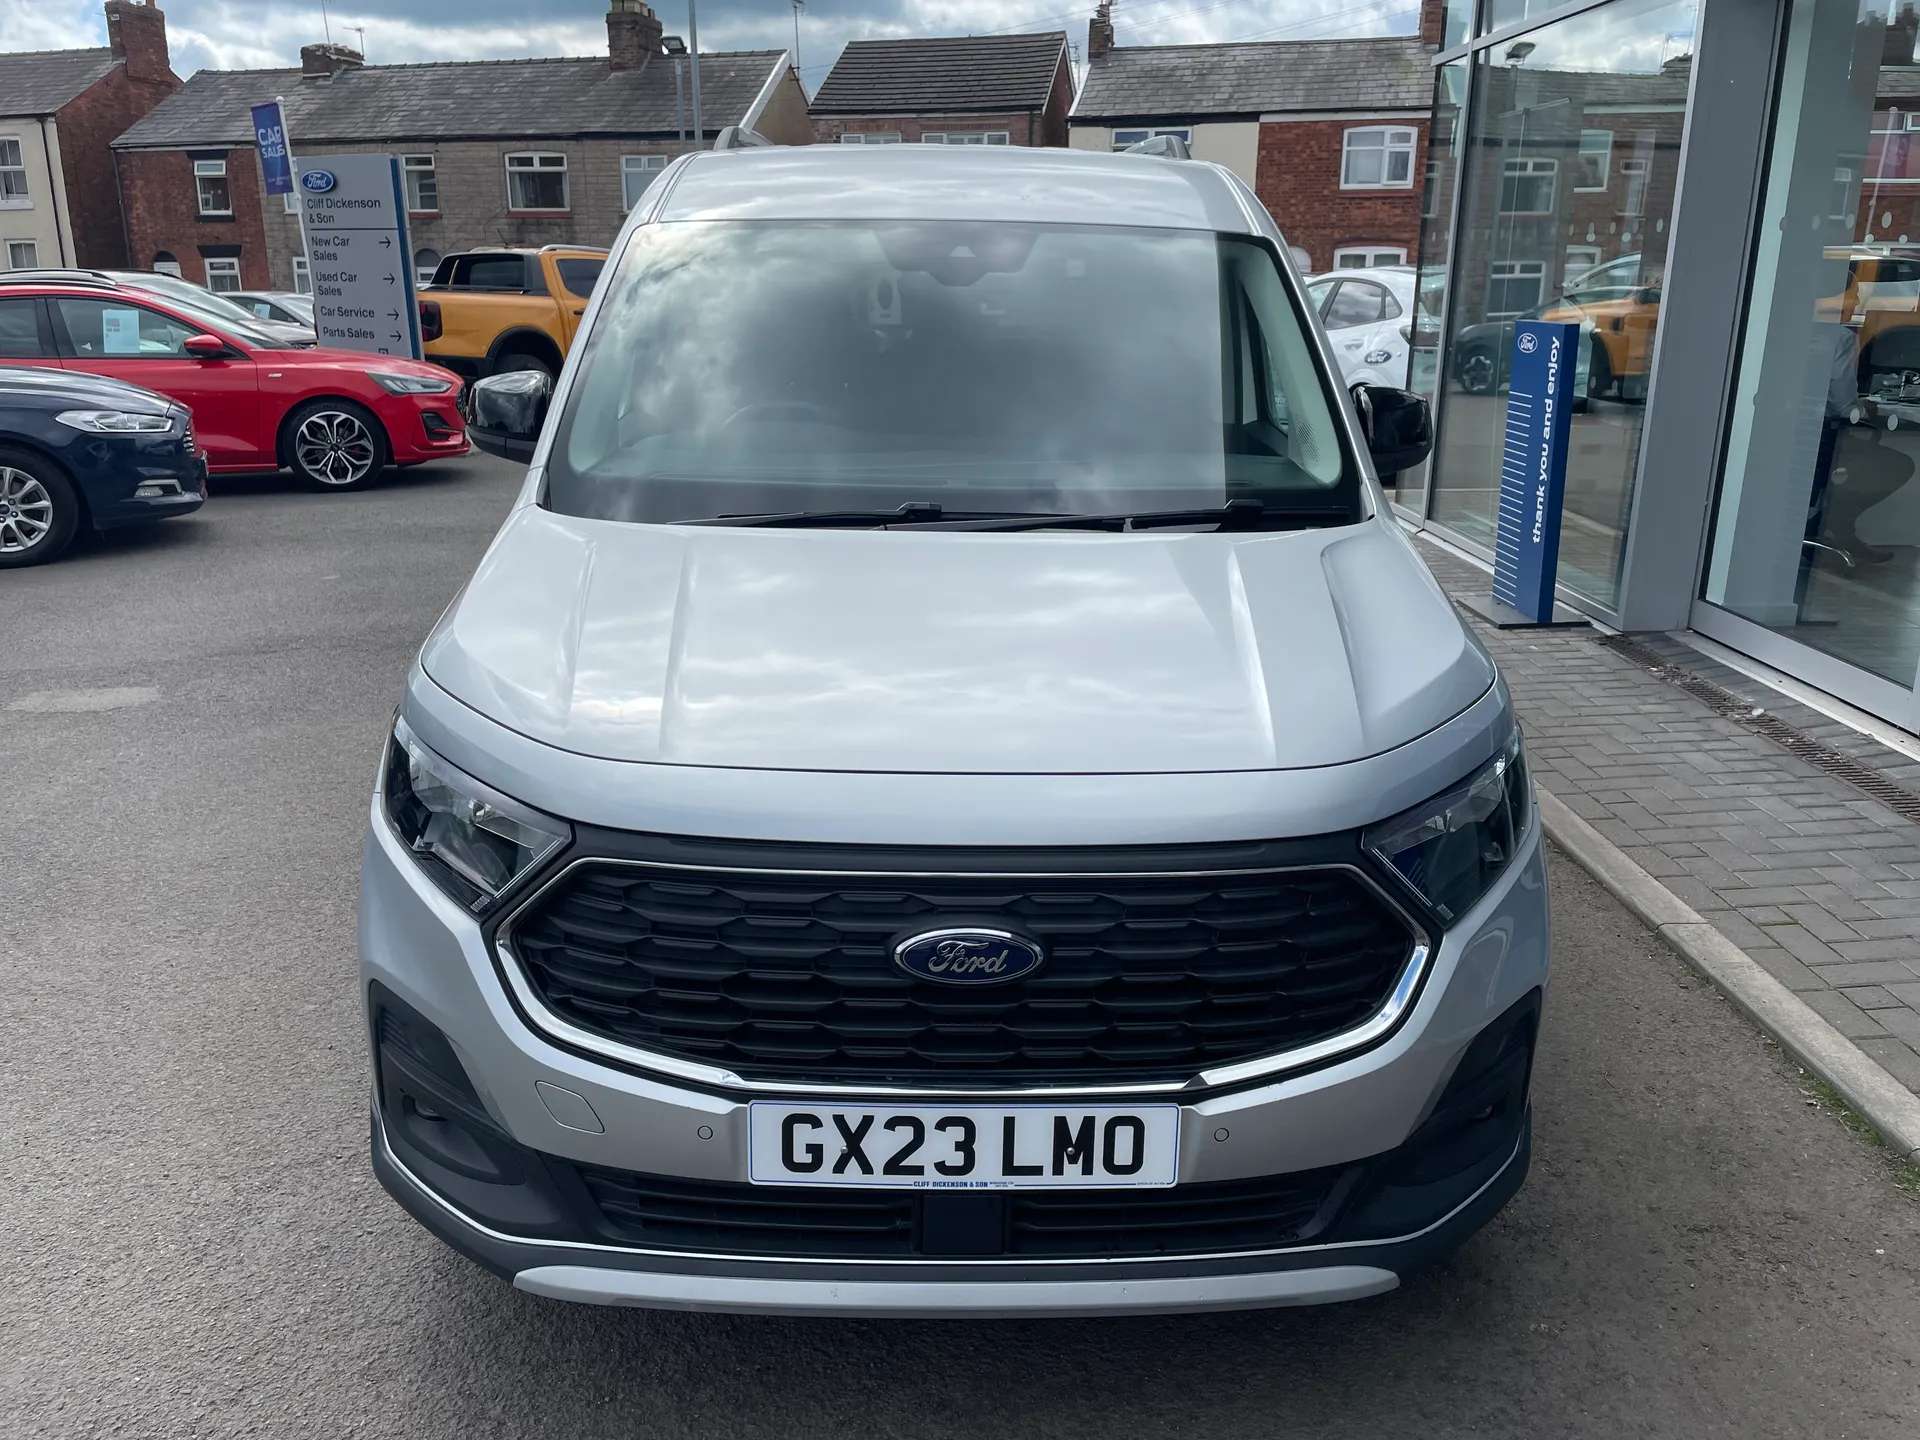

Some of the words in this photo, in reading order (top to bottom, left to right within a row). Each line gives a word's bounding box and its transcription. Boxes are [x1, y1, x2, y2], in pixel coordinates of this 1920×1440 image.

[307, 198, 324, 209] Cliff
[326, 198, 381, 209] Dickenson
[309, 213, 315, 223] &
[317, 213, 334, 223] Son
[312, 236, 331, 246] New
[332, 236, 350, 247] Car
[313, 250, 338, 261] Sales
[315, 272, 338, 282] Used
[340, 272, 357, 282] Car
[318, 286, 342, 296] Sales
[320, 306, 335, 316] Car
[337, 306, 375, 318] Service
[323, 327, 345, 338] Parts
[347, 328, 375, 339] Sales
[1547, 336, 1561, 394] enjoy
[1543, 399, 1553, 440] and
[1539, 445, 1549, 481] you
[1532, 484, 1545, 544] thank
[928, 940, 1009, 973] Ford
[781, 1112, 977, 1177] GX23
[1002, 1115, 1146, 1177] LMO
